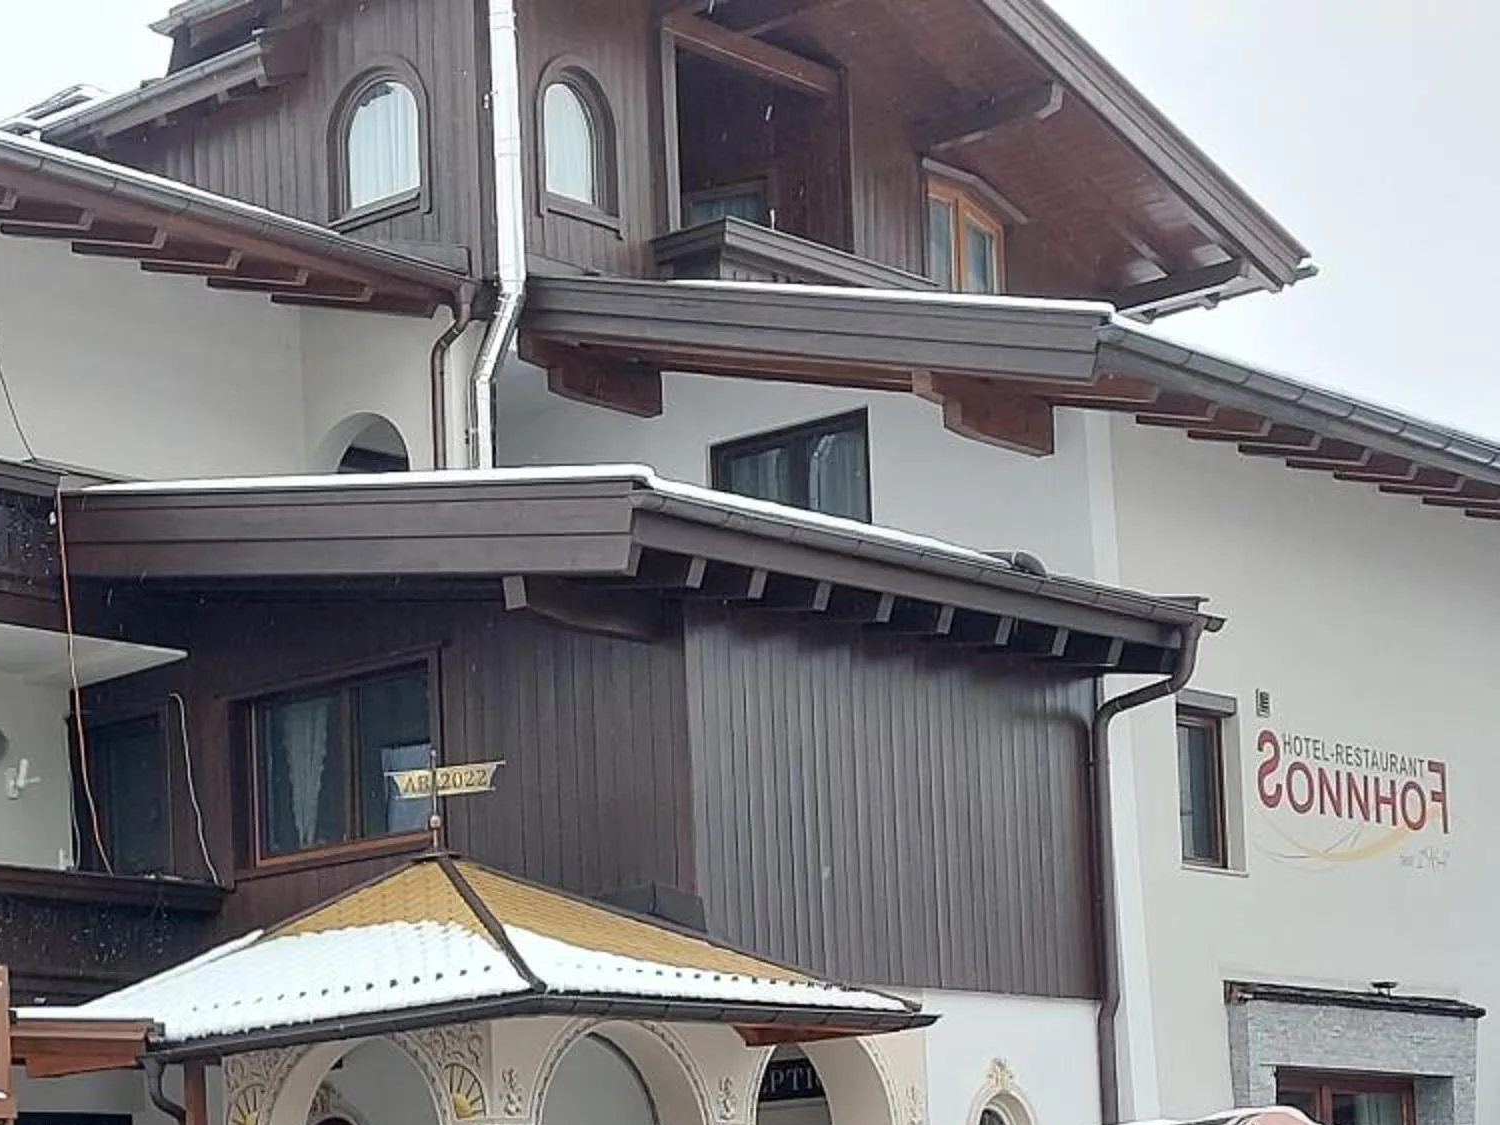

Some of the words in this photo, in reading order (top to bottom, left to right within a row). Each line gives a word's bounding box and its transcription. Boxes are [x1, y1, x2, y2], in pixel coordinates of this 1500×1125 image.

[1282, 732, 1425, 778] HOTEL-RESTAURANT
[438, 769, 487, 790] 2022
[1257, 729, 1449, 834] SONNHOF
